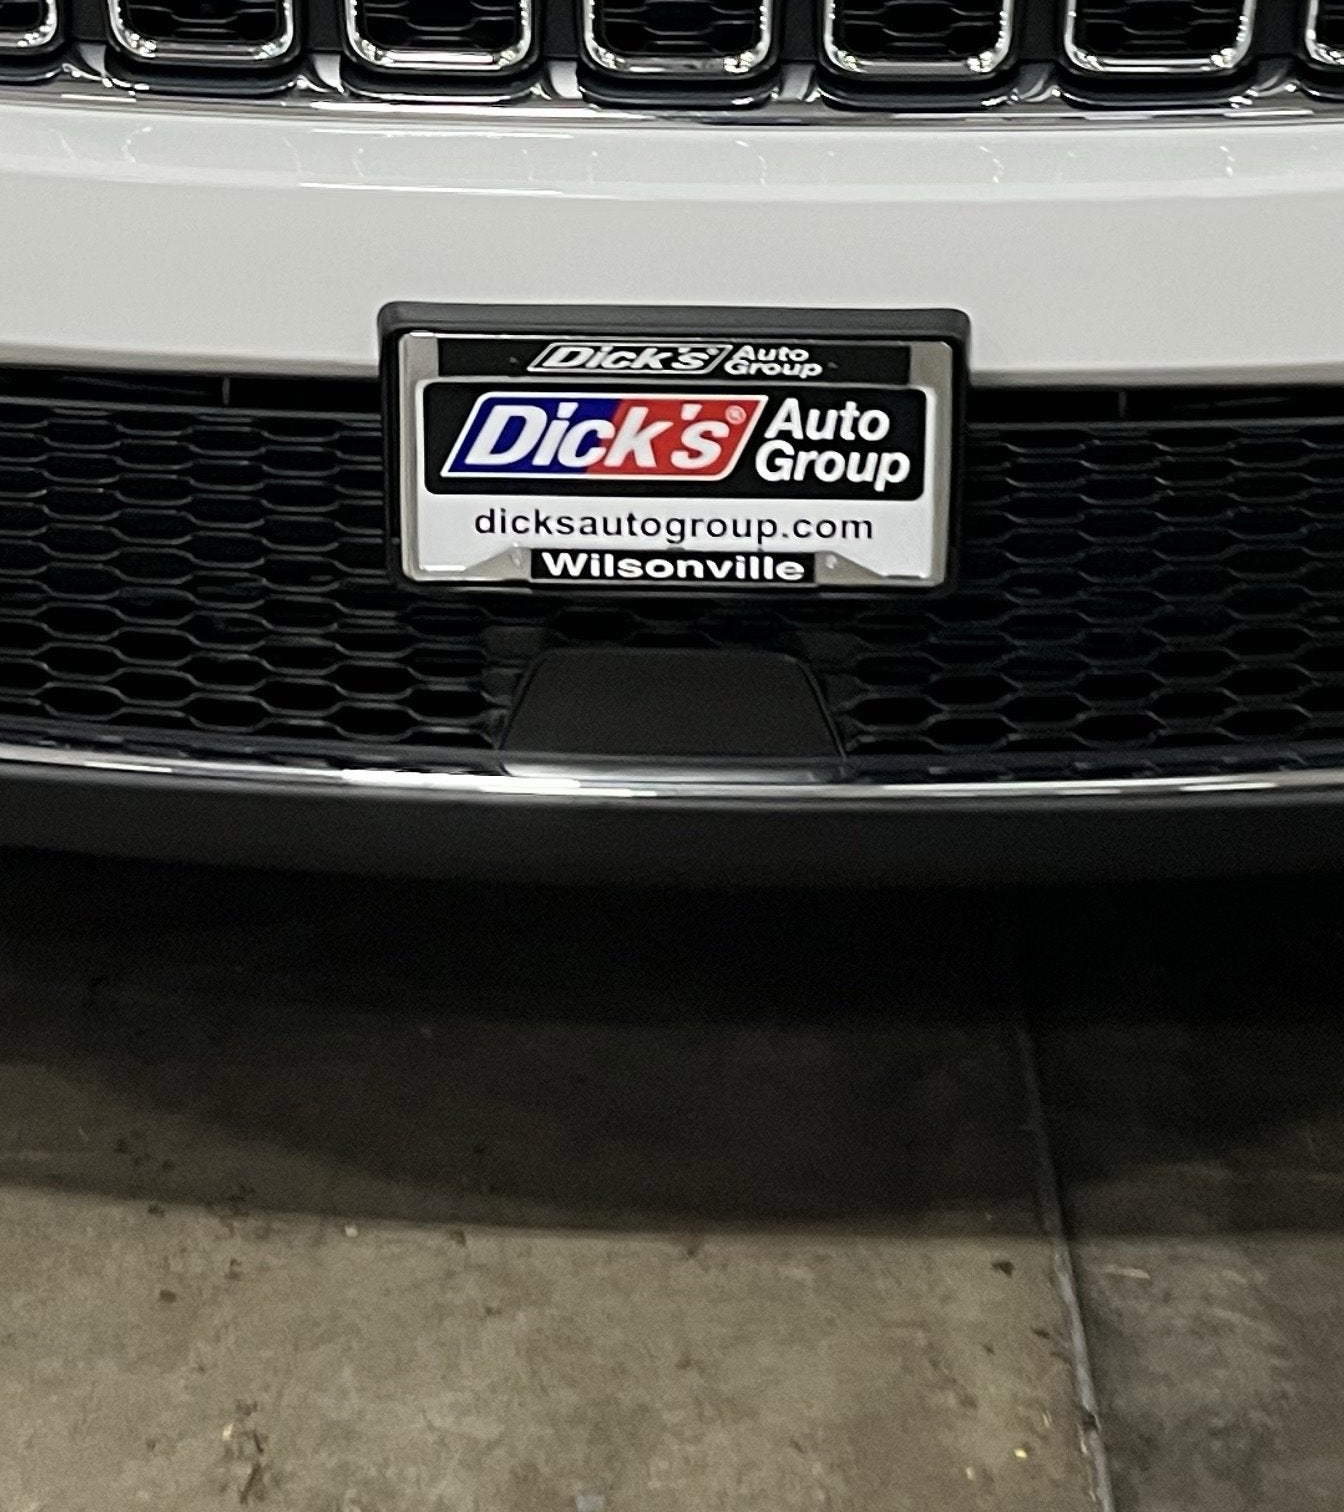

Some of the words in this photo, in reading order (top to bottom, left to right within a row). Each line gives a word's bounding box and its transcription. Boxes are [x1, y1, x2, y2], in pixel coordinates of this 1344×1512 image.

[724, 359, 823, 379] Group
[732, 345, 809, 361] Auto
[464, 402, 730, 469] Dick's
[766, 398, 891, 442] Auto
[756, 442, 910, 491] Group
[474, 508, 873, 544] dicksautogroup.com
[541, 551, 805, 582] Wilsonville
